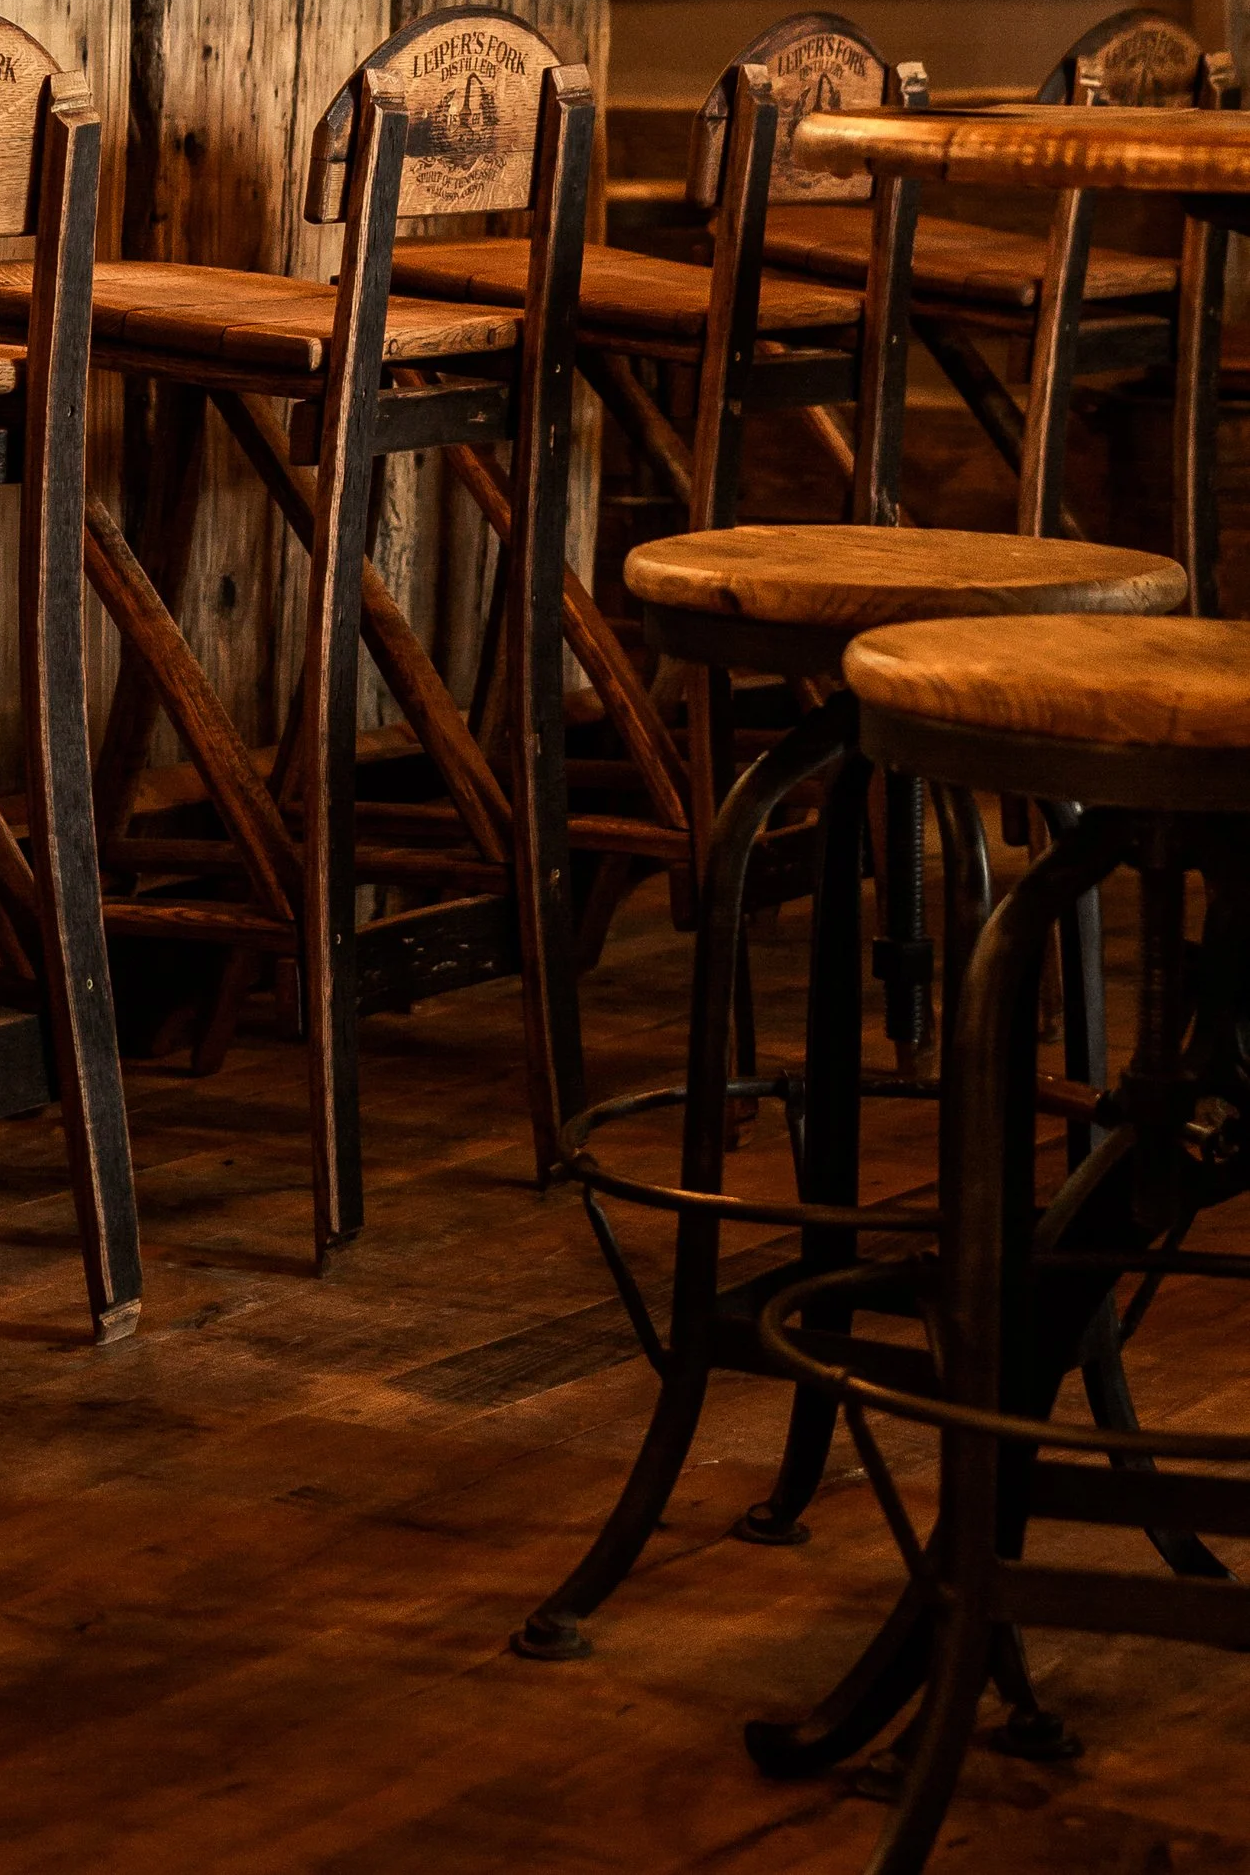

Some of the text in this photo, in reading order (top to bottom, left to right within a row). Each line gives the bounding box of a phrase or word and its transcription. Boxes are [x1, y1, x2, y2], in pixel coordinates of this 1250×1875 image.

[413, 31, 528, 78] LEIPER'S FORK
[836, 39, 865, 77] FORK
